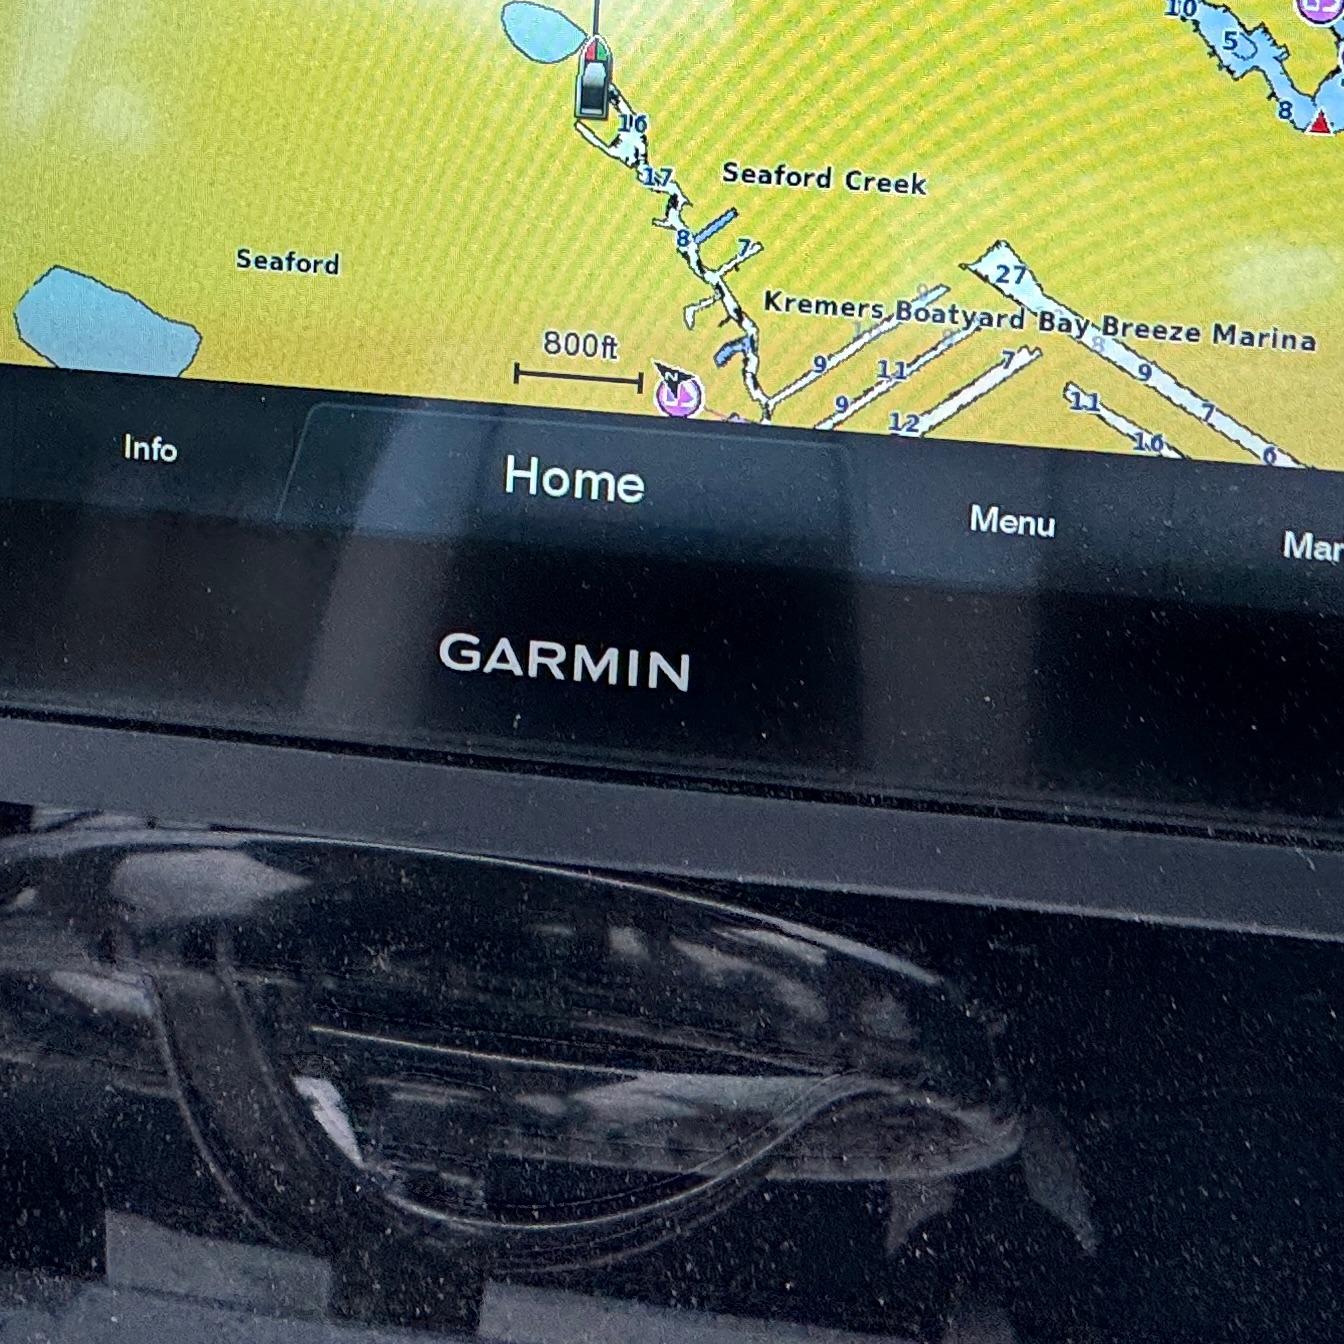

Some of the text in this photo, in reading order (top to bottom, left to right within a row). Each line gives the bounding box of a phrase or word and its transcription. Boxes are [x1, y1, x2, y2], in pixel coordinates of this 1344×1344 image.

[1223, 31, 1238, 50] 5
[1278, 101, 1293, 120] 8
[617, 113, 648, 133] 16
[642, 167, 673, 187] 17
[722, 161, 927, 196] Seaford Creek
[676, 229, 690, 247] 8
[736, 237, 751, 257] 7
[236, 247, 340, 278] Seaford
[996, 264, 1027, 285] 27
[765, 289, 884, 320] Kremers
[896, 299, 1025, 331] Boatyard
[1038, 311, 1090, 339] Bay
[1102, 315, 1201, 343] Breeze
[1213, 322, 1317, 351] Marina
[543, 330, 619, 360] 800ft
[814, 354, 827, 373] 9
[877, 359, 907, 380] 11
[1001, 350, 1016, 369] 7
[1138, 363, 1153, 382] 9
[836, 395, 850, 414] 9
[1069, 391, 1101, 411] 11
[889, 412, 920, 433] 12
[1201, 401, 1216, 423] 7
[124, 433, 178, 463] Info
[504, 454, 646, 505] Home
[970, 503, 1056, 539] Menu
[438, 631, 691, 693] GARMIN
